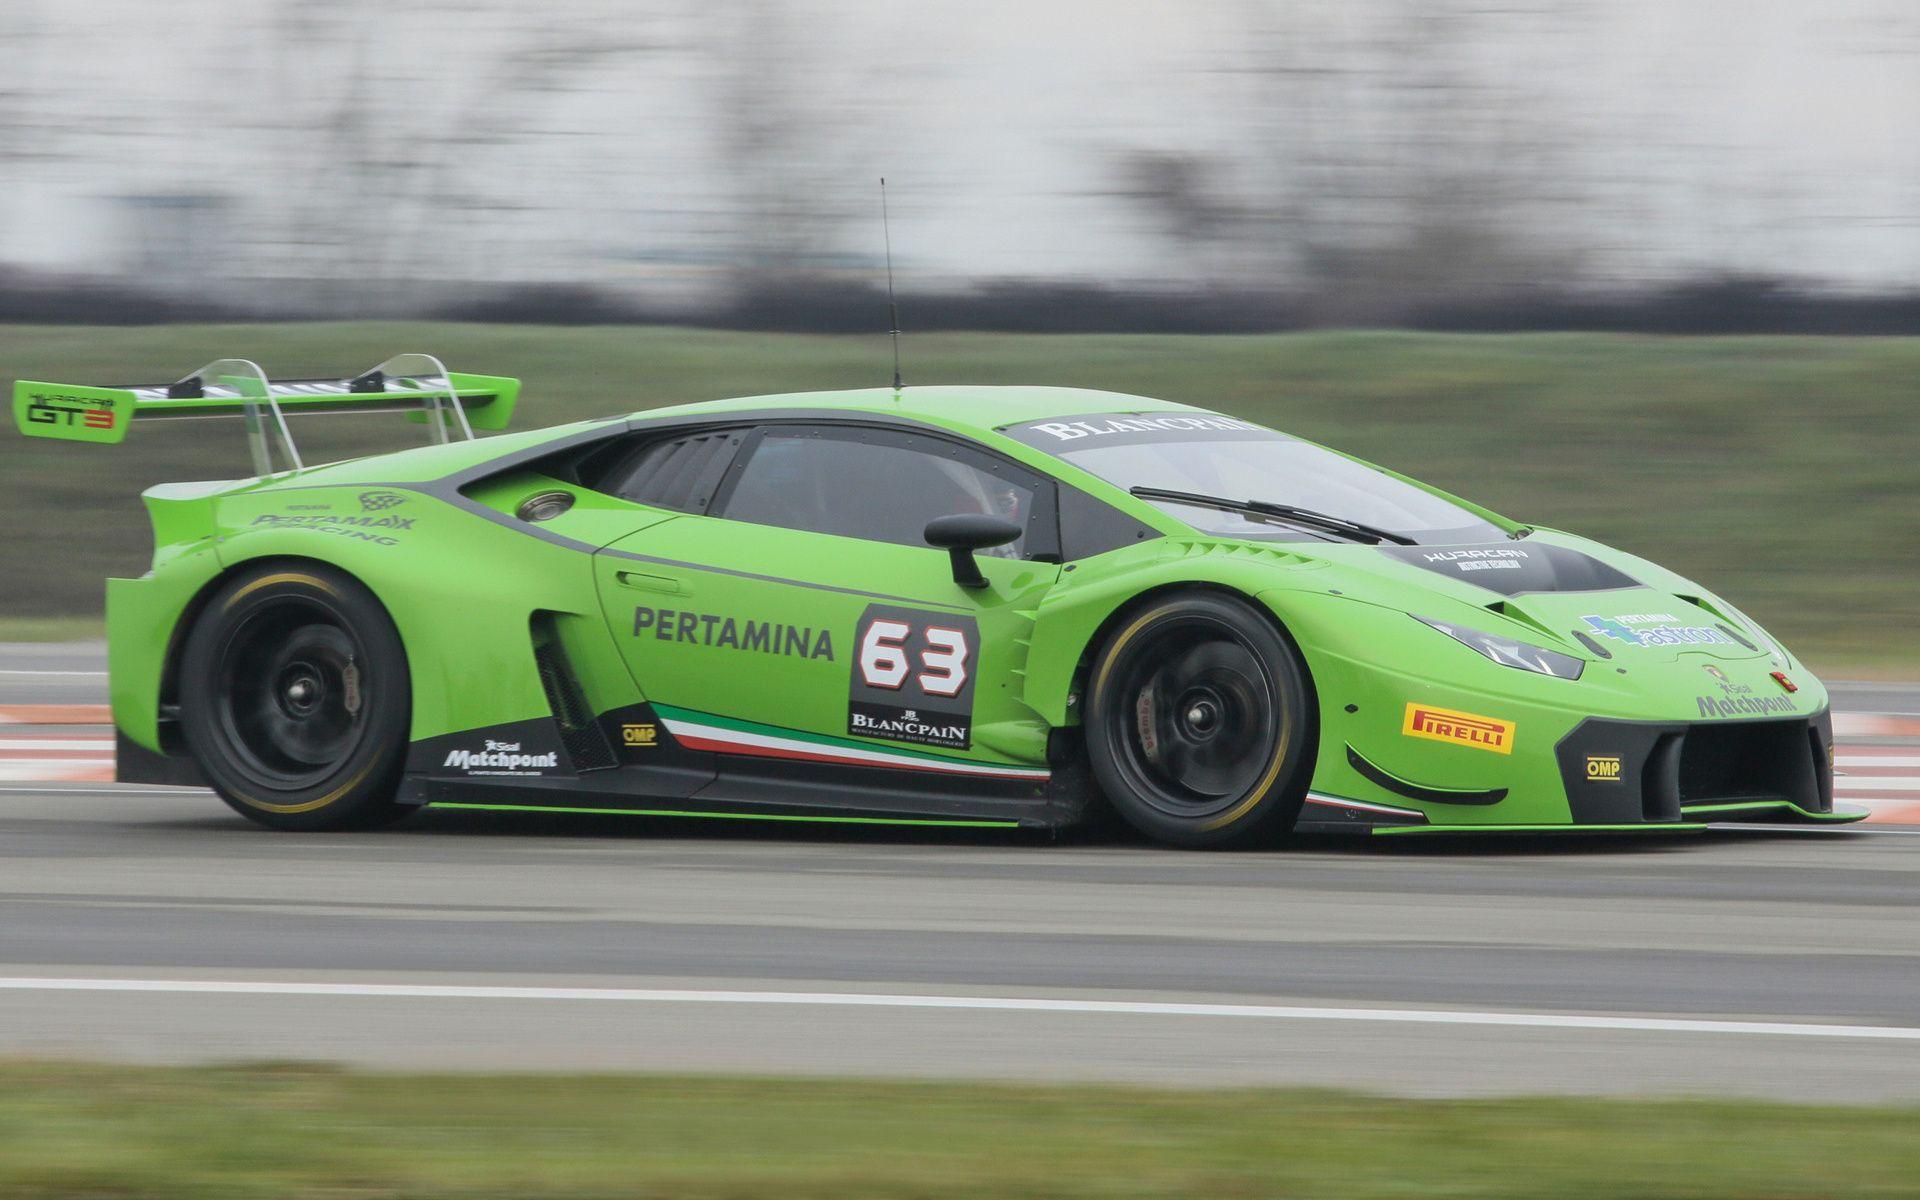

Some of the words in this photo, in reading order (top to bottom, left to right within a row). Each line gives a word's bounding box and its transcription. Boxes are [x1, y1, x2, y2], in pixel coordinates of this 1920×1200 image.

[28, 404, 114, 429] GT3
[1423, 549, 1529, 562] HURACAN
[633, 606, 834, 662] PERTAMINA
[859, 618, 969, 699] 63
[1696, 692, 1798, 718] Matchpoint
[623, 728, 656, 741] OMP
[852, 713, 967, 740] BLANCPAIN
[1413, 710, 1505, 746] PIRELLI
[443, 750, 558, 770] Matchpoint
[1587, 761, 1620, 776] OMP
